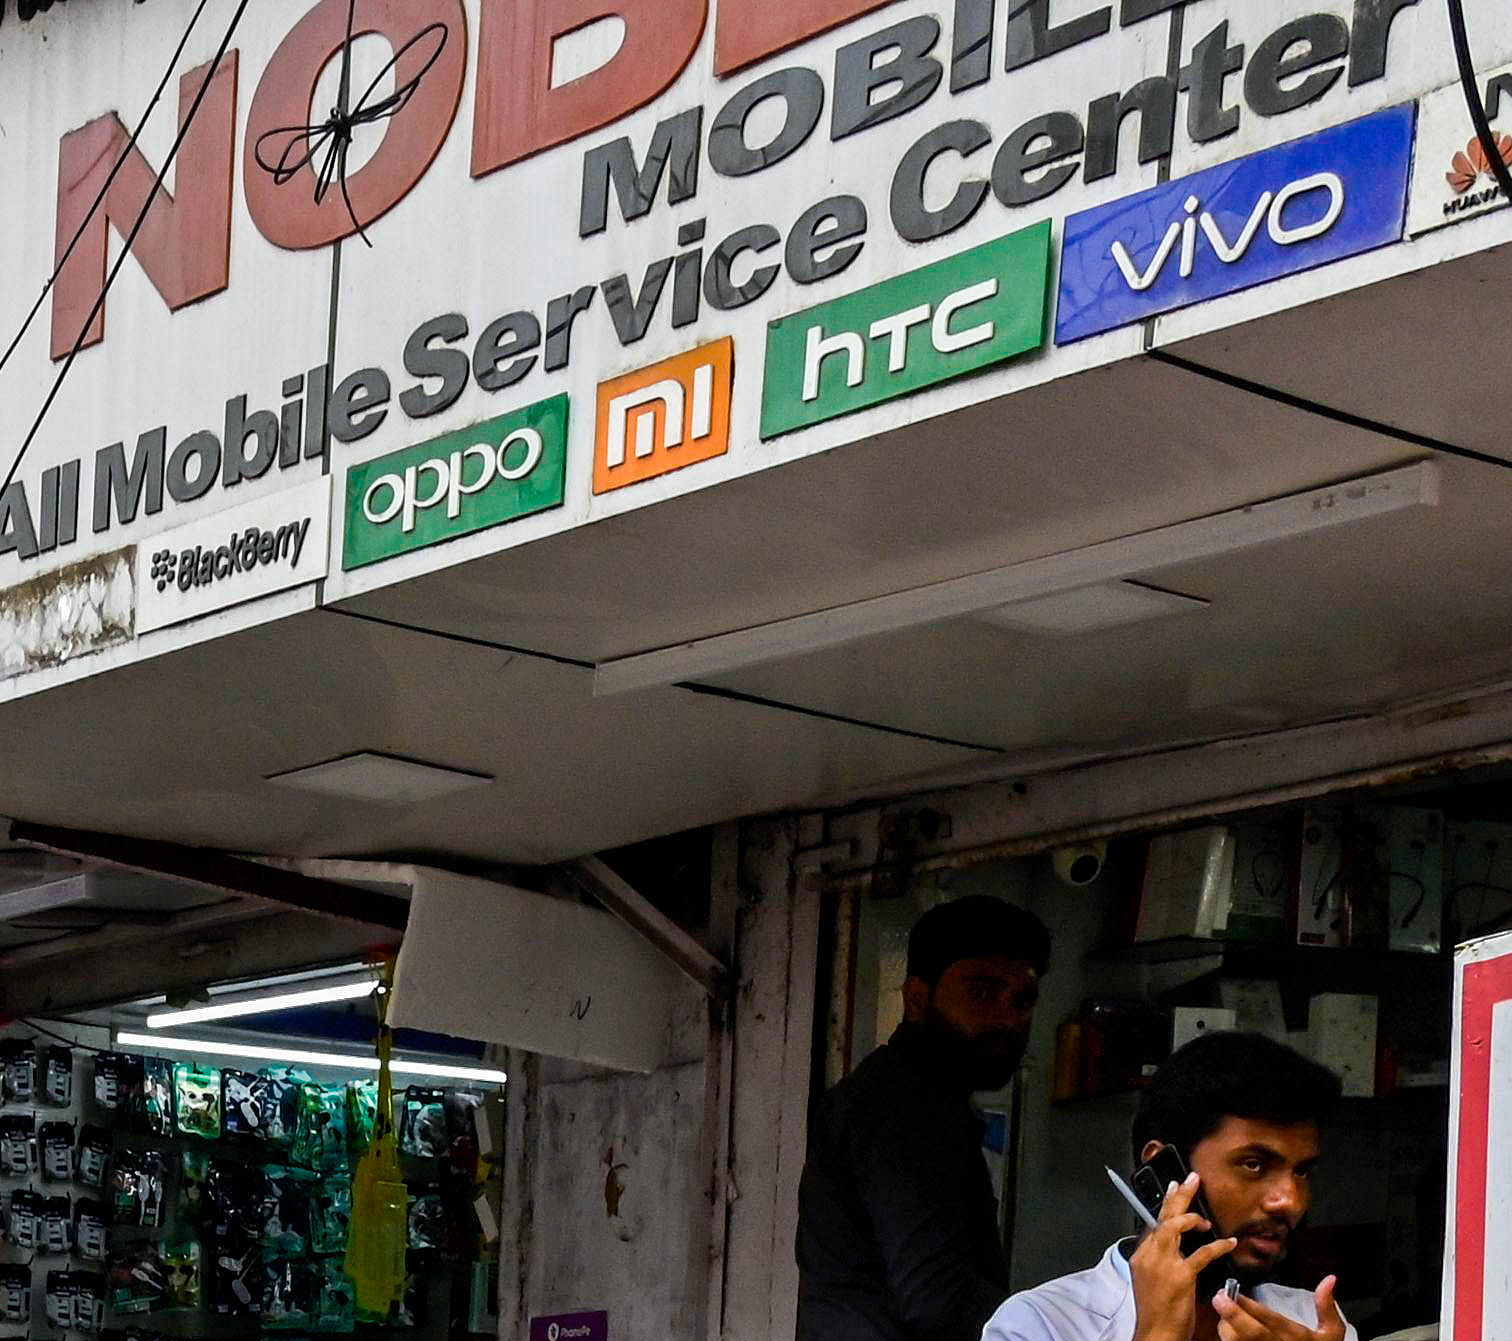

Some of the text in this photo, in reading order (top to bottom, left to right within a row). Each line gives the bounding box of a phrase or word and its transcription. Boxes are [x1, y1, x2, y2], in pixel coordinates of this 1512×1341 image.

[50, 0, 881, 362] NOB
[1112, 170, 1346, 292] vivo
[1442, 186, 1502, 216] HUAW
[93, 359, 390, 530] Mobile
[399, 195, 868, 420] Service
[888, 0, 1419, 244] Center
[177, 516, 312, 590] BlackBerry
